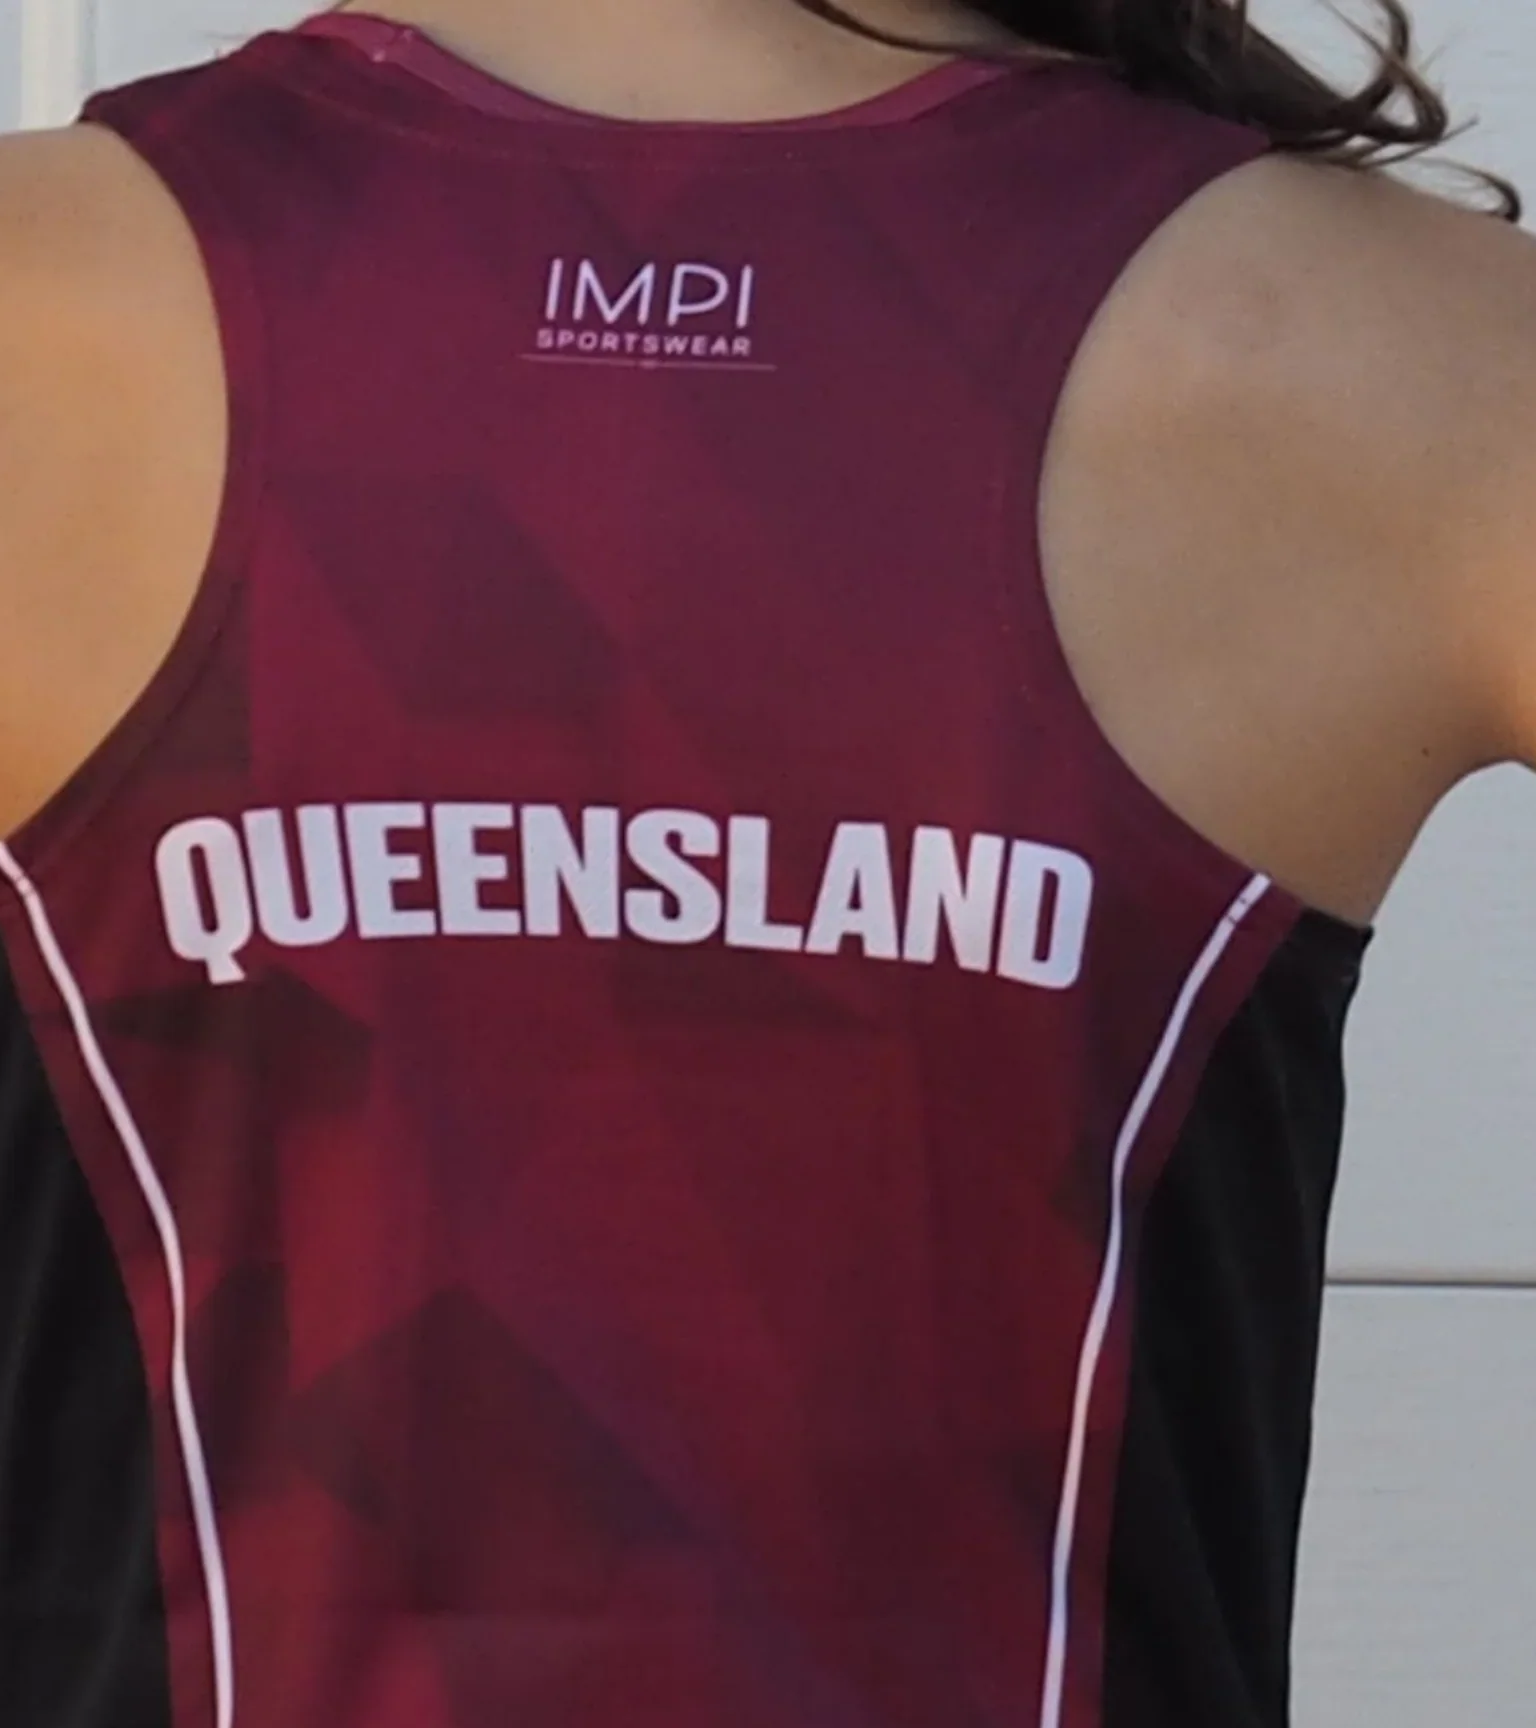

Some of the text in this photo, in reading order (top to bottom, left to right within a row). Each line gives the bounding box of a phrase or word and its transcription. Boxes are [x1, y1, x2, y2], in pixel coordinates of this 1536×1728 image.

[545, 258, 754, 329] IMPI
[536, 329, 752, 357] SPORTSWEAR
[154, 802, 1093, 988] QUEENSLAND
